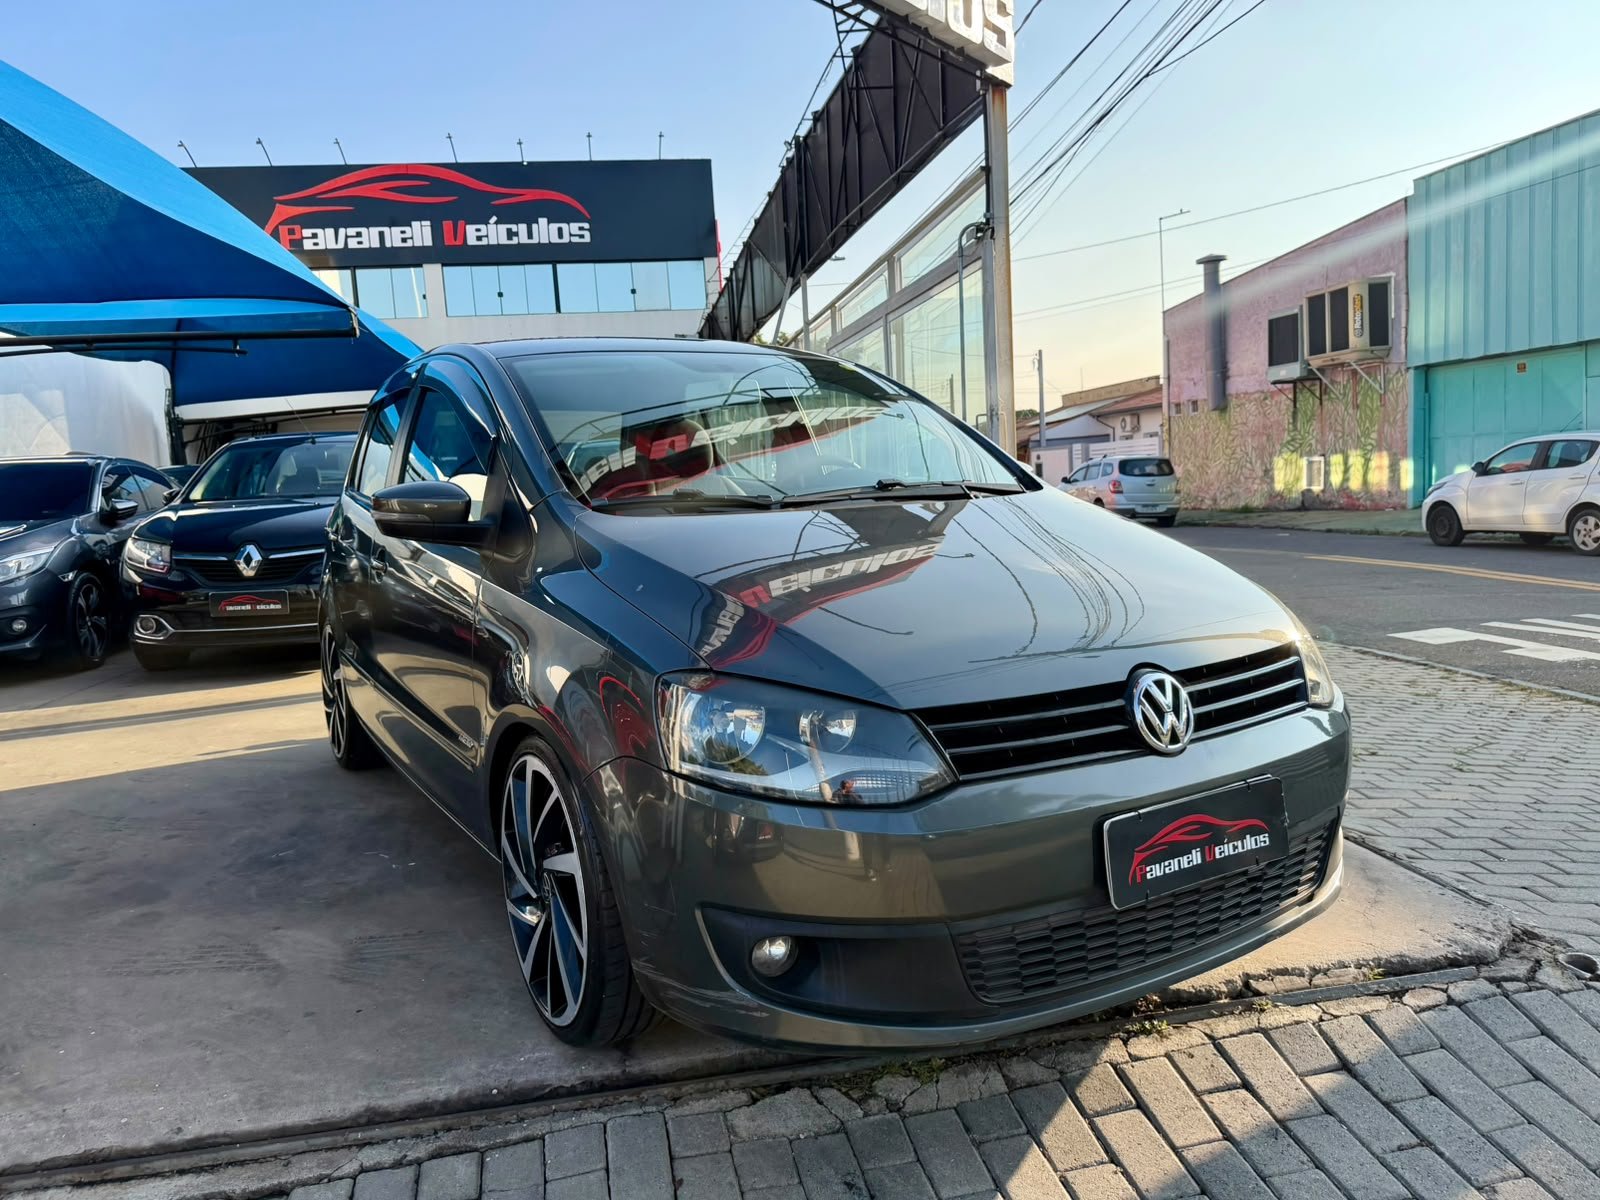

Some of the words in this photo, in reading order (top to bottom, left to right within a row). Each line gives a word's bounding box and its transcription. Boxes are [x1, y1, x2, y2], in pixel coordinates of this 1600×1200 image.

[279, 220, 433, 251] Pavaneli
[442, 215, 591, 246] Veículos
[1136, 848, 1202, 883] Pavaneli
[1204, 832, 1270, 864] Veículos
